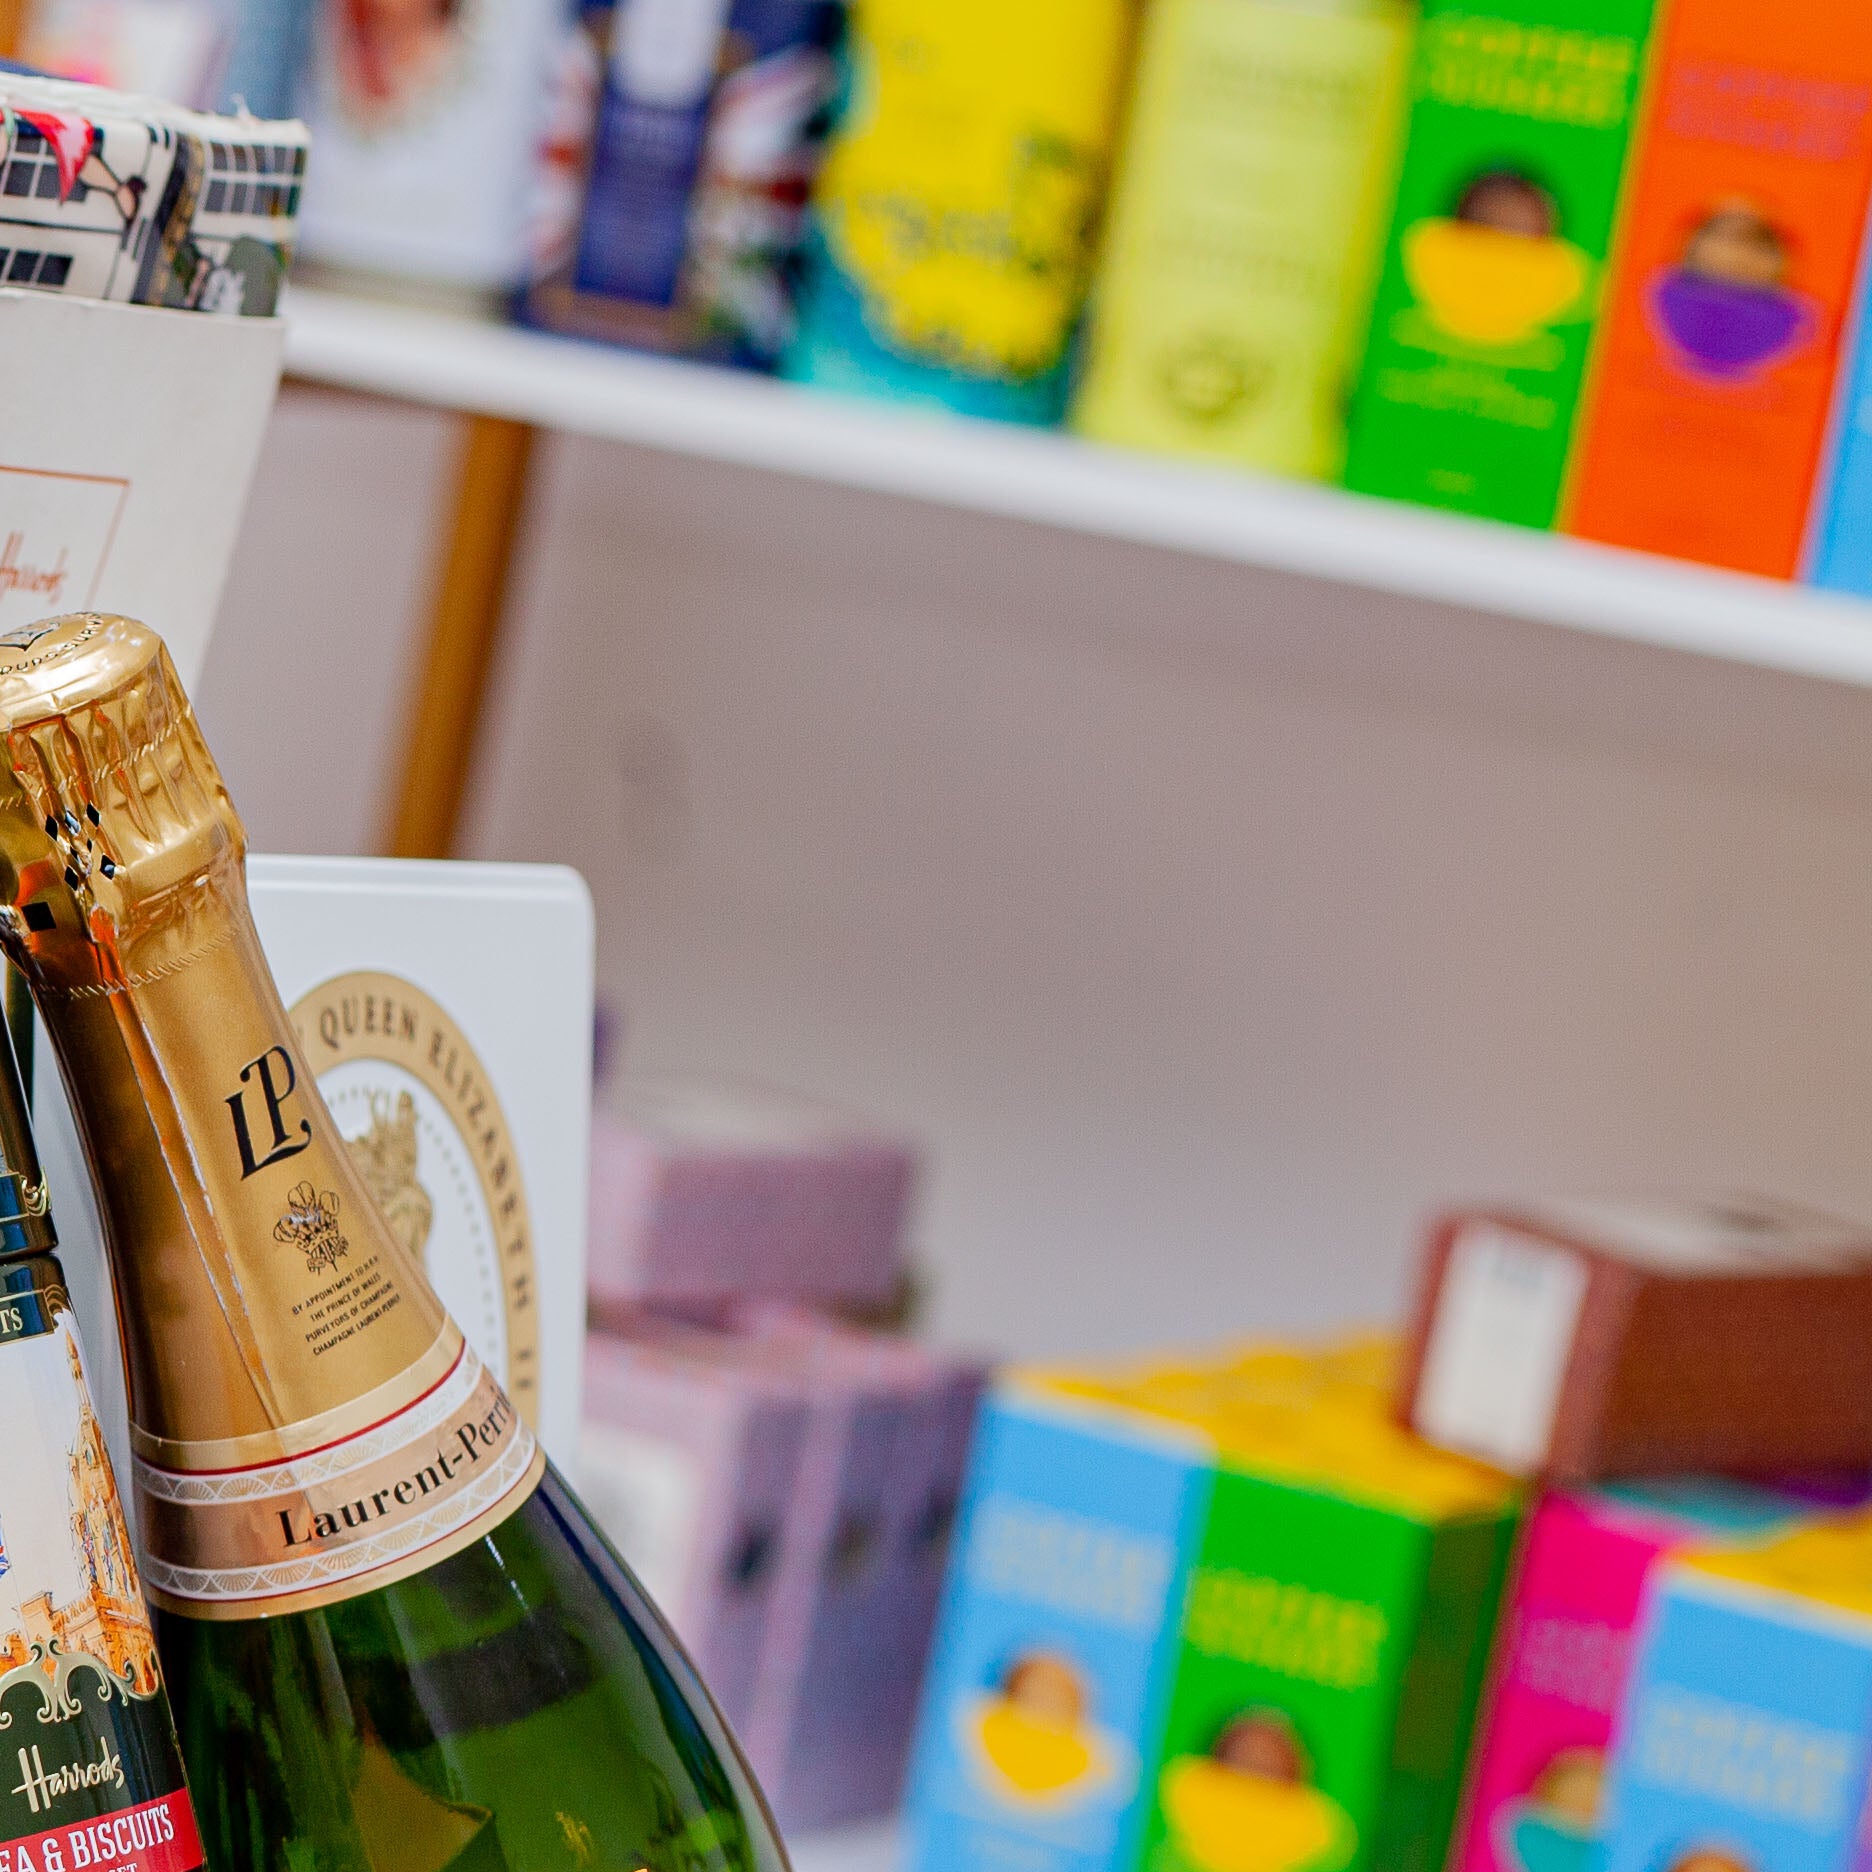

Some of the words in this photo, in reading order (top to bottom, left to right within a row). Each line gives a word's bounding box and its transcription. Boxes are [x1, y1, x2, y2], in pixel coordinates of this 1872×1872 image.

[318, 994, 418, 1050] QUEEN
[305, 1271, 356, 1309] APPOINTMENT
[326, 1292, 353, 1314] PRINCE
[11, 1736, 125, 1814] Harrods
[68, 1802, 176, 1869] BISCUITS
